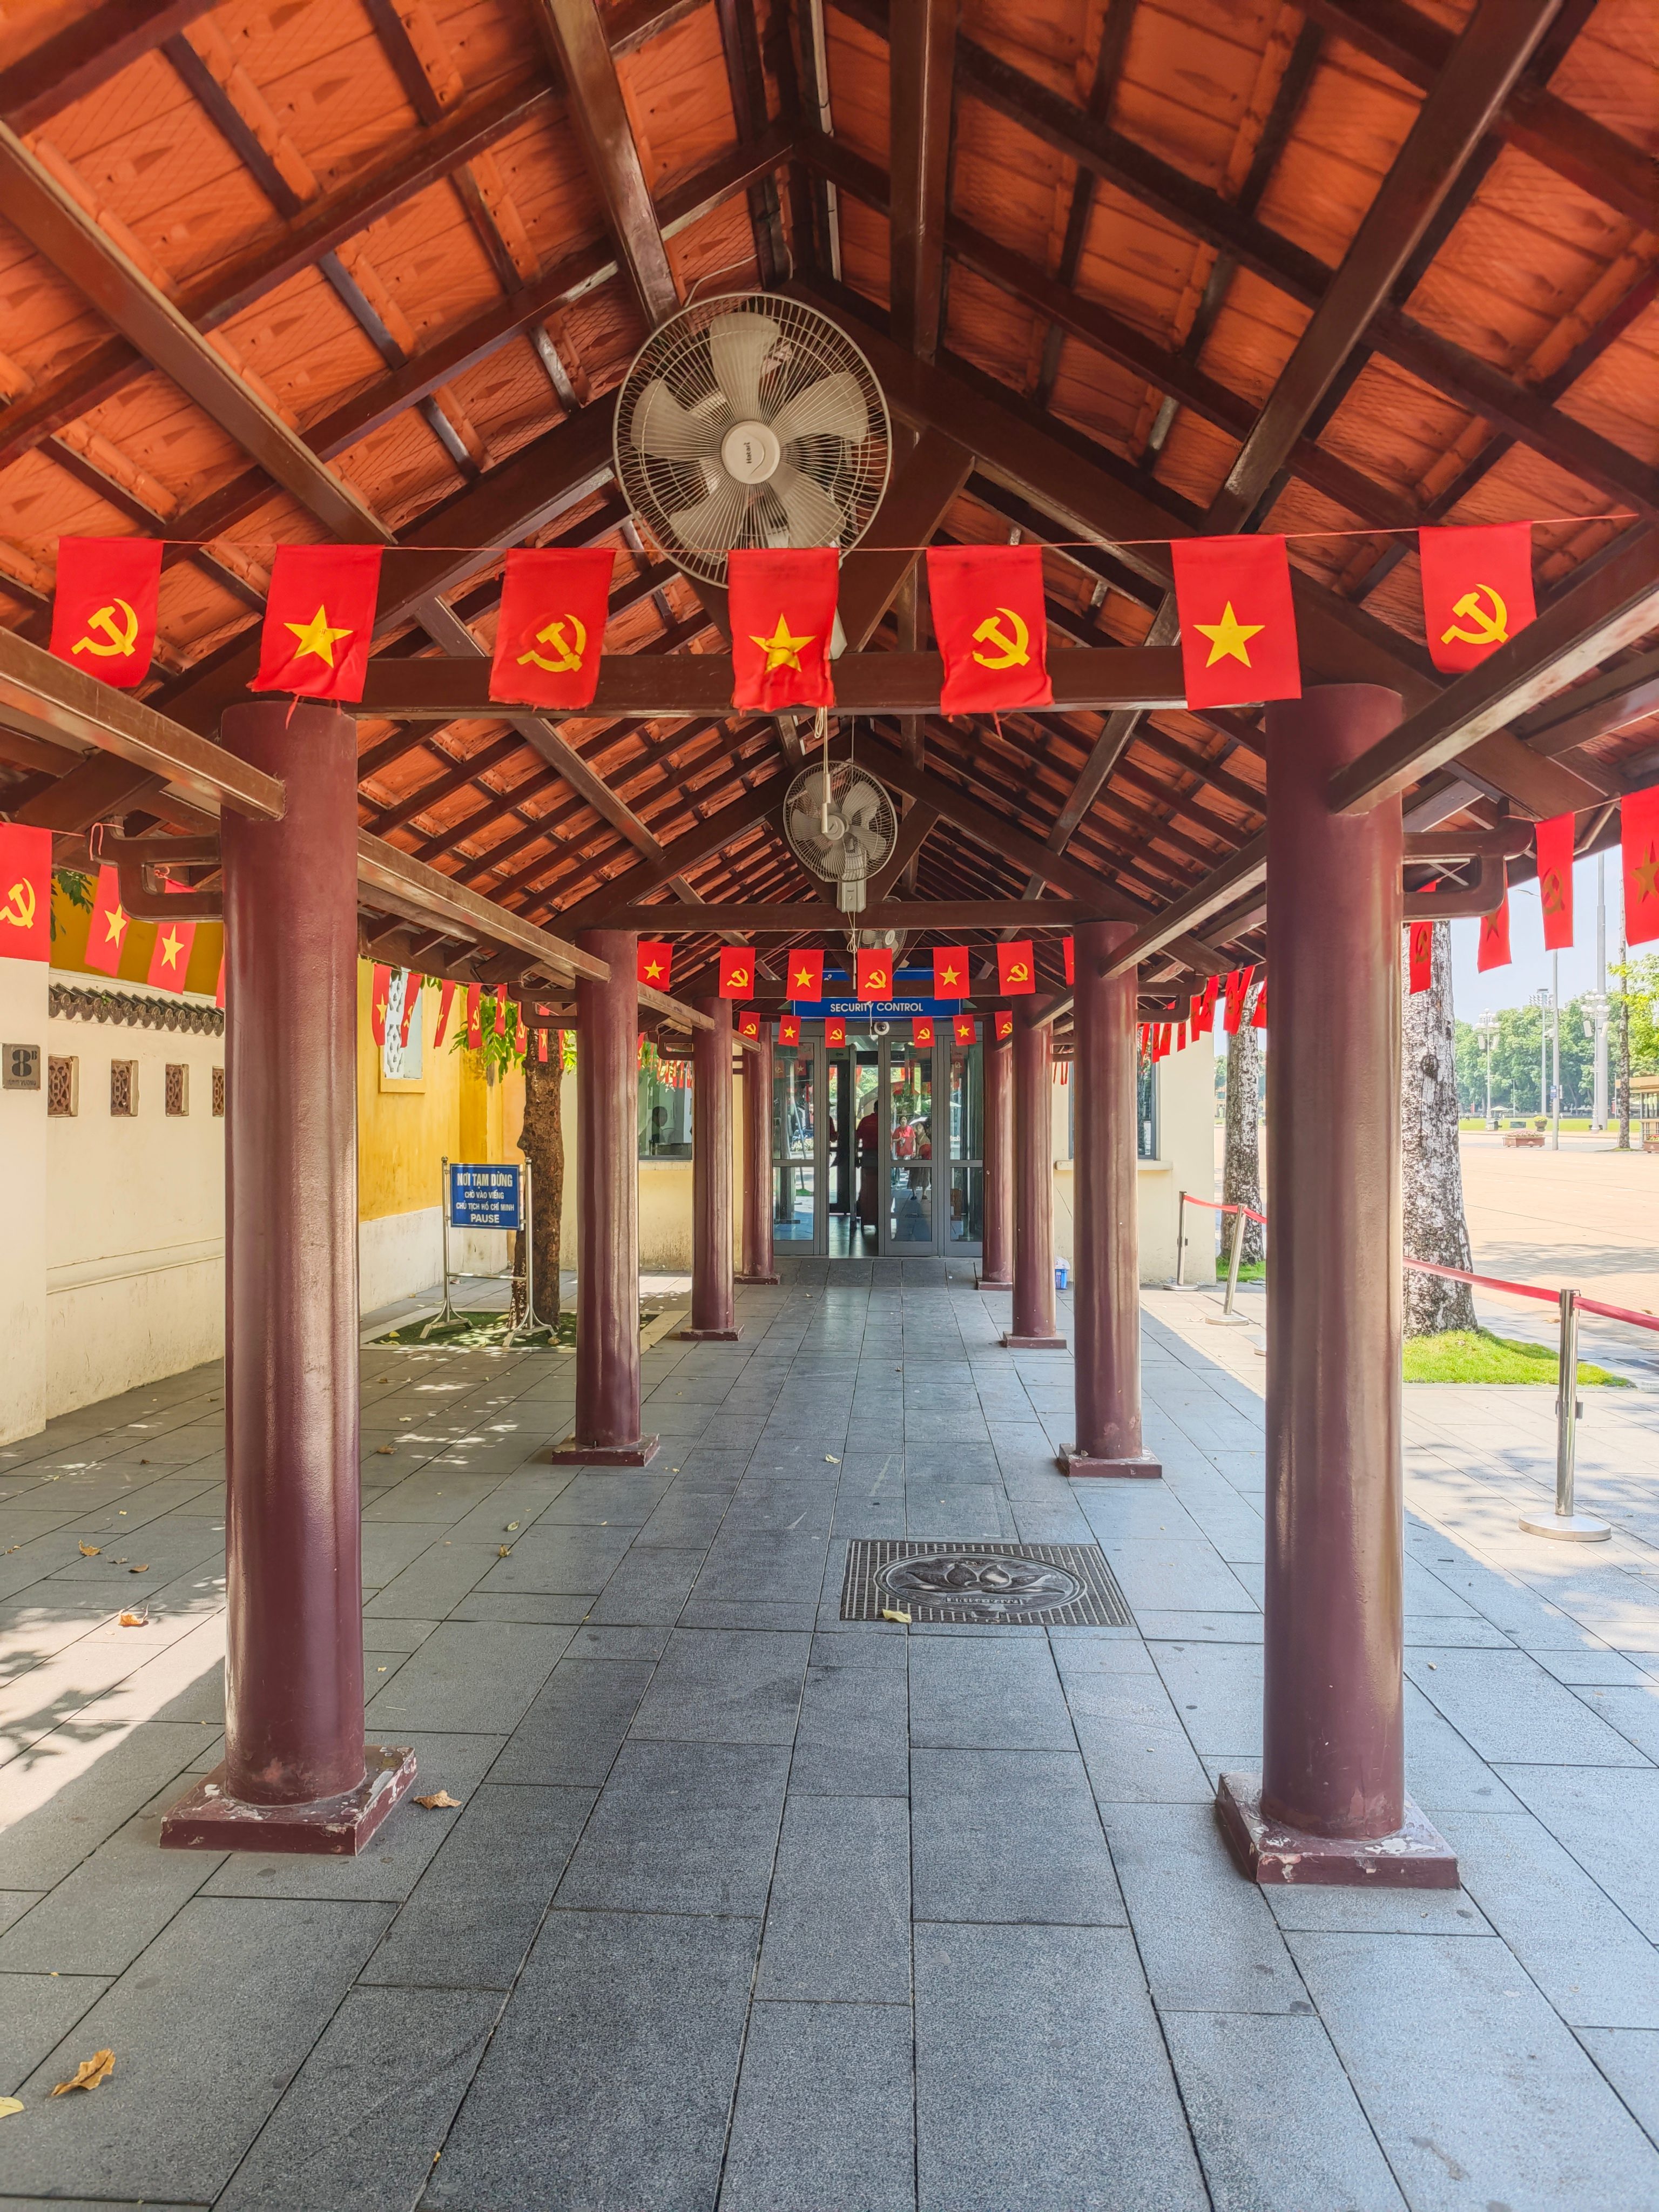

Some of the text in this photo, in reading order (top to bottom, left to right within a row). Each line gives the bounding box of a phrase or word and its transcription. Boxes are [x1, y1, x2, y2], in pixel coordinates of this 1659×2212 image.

[830, 1002, 923, 1012] SECURITY CONTROL
[457, 1171, 513, 1189] NƠI TẠM DỪNG
[464, 1189, 504, 1199] CHỜ VÀO VIẾNG
[456, 1200, 467, 1210] CHỦ
[468, 1203, 480, 1211] TỊCH
[490, 1202, 499, 1211] CHÍ
[470, 1213, 500, 1224] PAUSE
